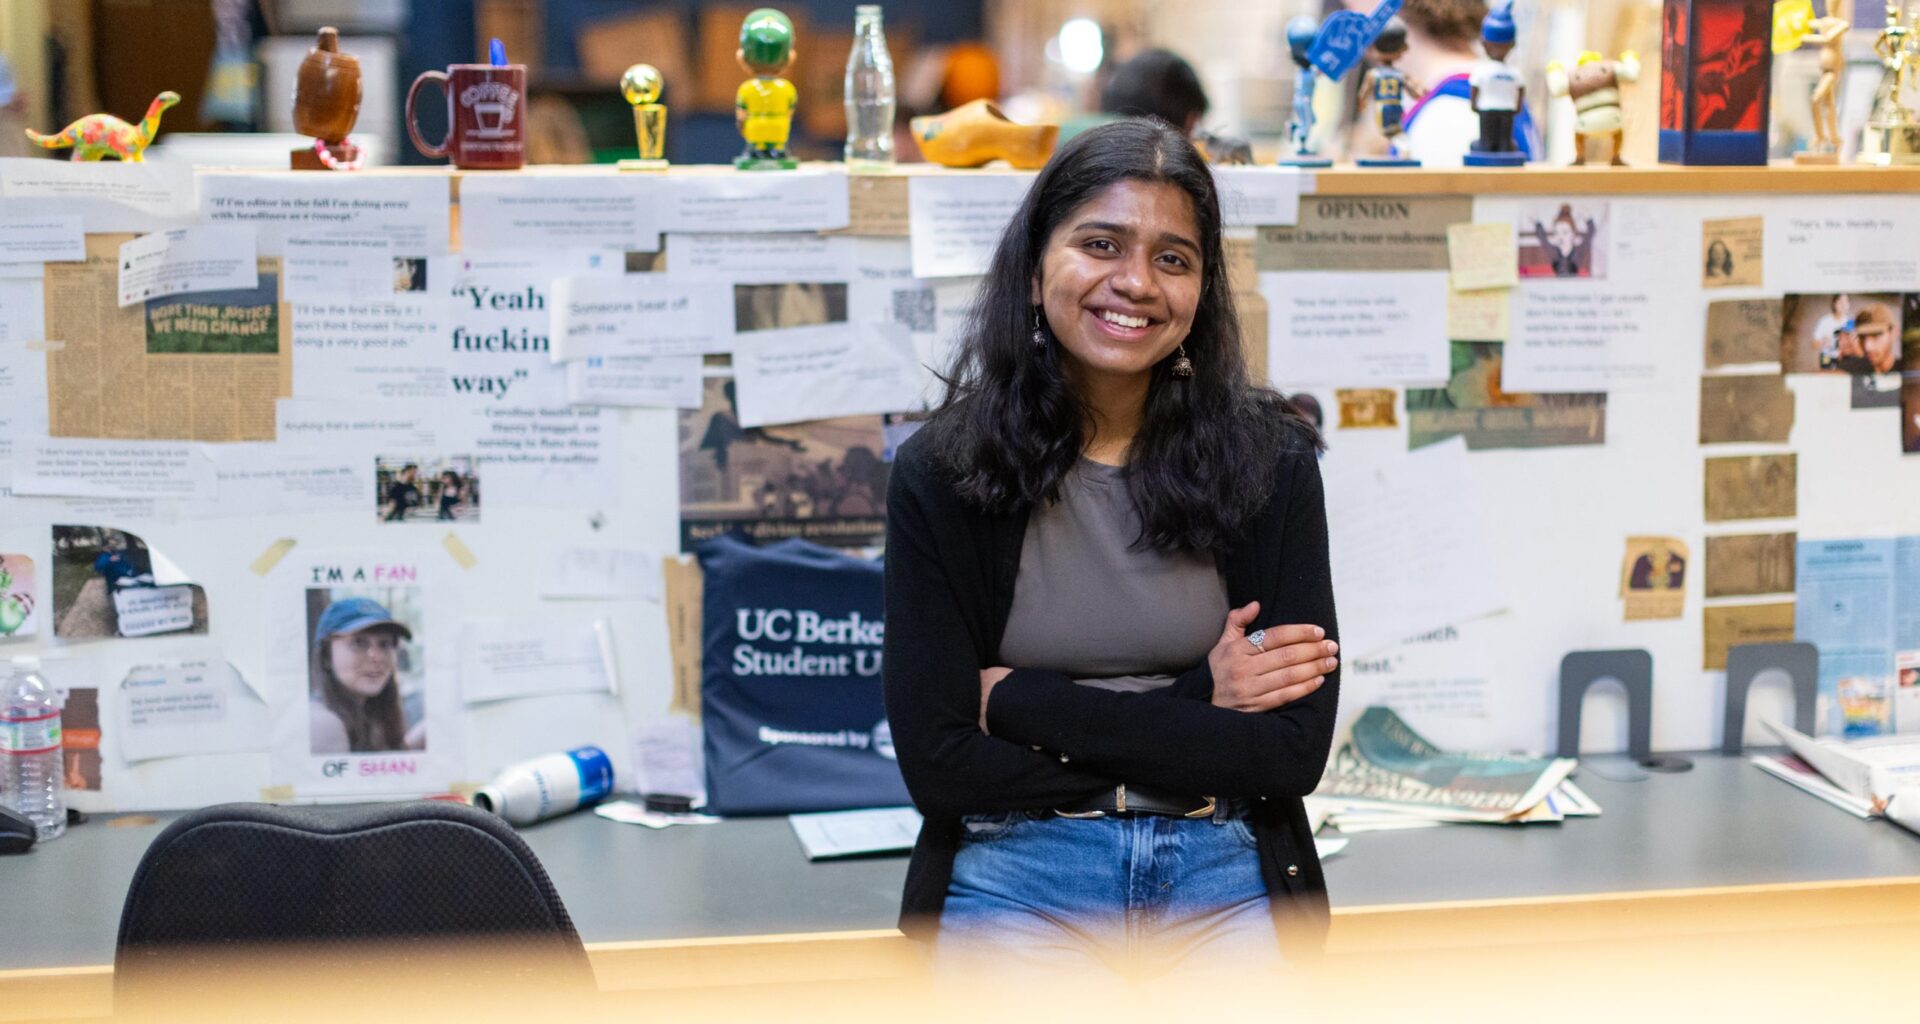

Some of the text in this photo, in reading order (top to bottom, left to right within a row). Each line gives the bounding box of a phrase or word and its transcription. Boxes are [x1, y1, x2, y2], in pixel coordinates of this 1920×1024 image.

[246, 199, 277, 208] editor
[294, 199, 310, 208] the
[352, 199, 381, 209] doing
[383, 201, 409, 210] away
[1317, 202, 1409, 218] OPINION
[211, 211, 235, 221] with
[237, 211, 287, 221] headlines
[452, 284, 544, 310] “Yeah
[225, 304, 272, 321] JUSTICE
[153, 317, 268, 336] WE NEED CHANGE
[453, 326, 549, 352] fuckin
[451, 369, 528, 400] way”
[508, 453, 599, 463] before deadline
[311, 564, 417, 582] I'M A FAN
[736, 608, 885, 646] UC Berke
[731, 643, 884, 677] Student U
[758, 725, 870, 749] Sponsored by
[321, 757, 418, 778] OF SHAN
